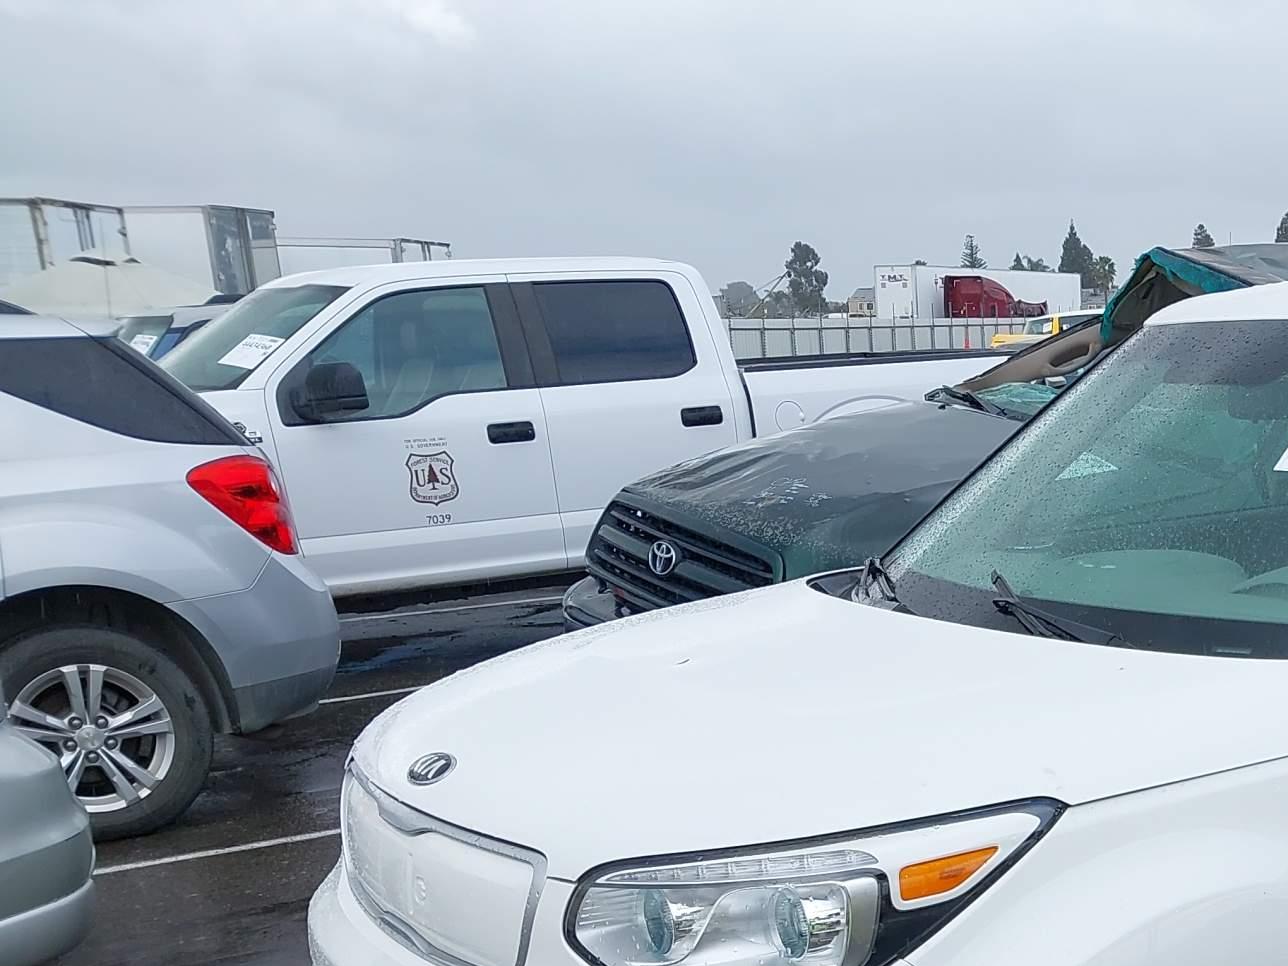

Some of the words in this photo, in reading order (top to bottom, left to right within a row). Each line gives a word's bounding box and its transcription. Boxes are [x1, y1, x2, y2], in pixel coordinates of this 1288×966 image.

[414, 469, 425, 487] U
[440, 468, 451, 485] S
[426, 514, 452, 524] 7039
